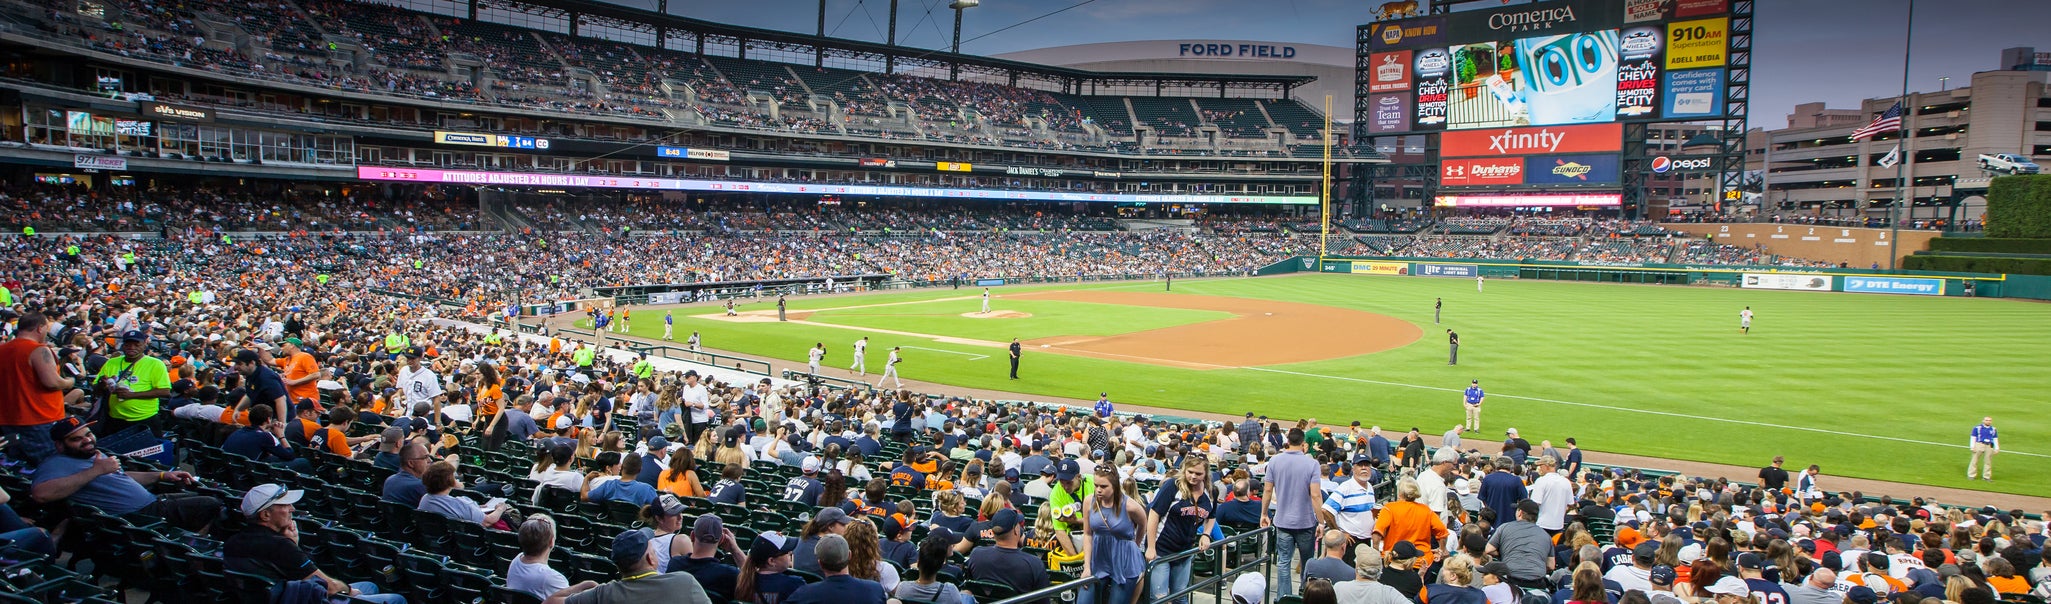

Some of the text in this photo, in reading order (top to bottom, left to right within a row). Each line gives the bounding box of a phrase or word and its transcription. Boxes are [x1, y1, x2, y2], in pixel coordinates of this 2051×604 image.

[1632, 3, 1654, 13] SOLD
[1633, 10, 1656, 20] NAME
[1404, 26, 1437, 37] KNOW HOW
[1511, 21, 1552, 32] PARK
[1385, 30, 1400, 39] NAPA
[1673, 26, 1722, 42] 910 AM
[1672, 40, 1721, 50] Superstation
[1179, 44, 1296, 58] FORD FIELD
[1671, 54, 1720, 64] ADELL MEDIA
[1618, 70, 1656, 81] CHEVY
[1672, 71, 1716, 80] Confidence
[1618, 80, 1655, 89] DRIVES
[1699, 77, 1716, 85] with
[1419, 86, 1447, 95] CHEVY
[1626, 88, 1654, 96] MOTOR
[1671, 85, 1692, 93] every
[1419, 94, 1447, 103] DRIVES
[1617, 90, 1626, 107] THE
[1626, 95, 1655, 106] CITY
[176, 109, 205, 118] VISION
[1376, 110, 1401, 119] Team
[1425, 107, 1446, 117] CITY
[1489, 129, 1565, 153] xfinity
[77, 154, 97, 164] 97.1
[98, 158, 125, 167] TICKET
[1671, 157, 1711, 171] pepsi
[1007, 166, 1018, 175] JACK
[1471, 163, 1520, 176] Dunham's
[1552, 165, 1590, 174] SUNOCO
[442, 172, 589, 186] ATTITUDES ADJUSTED 24 HOURS A DAY
[1425, 264, 1440, 274] Lite
[1892, 282, 1933, 291] Energy
[891, 472, 914, 481] CABRERA
[710, 485, 725, 498] 3
